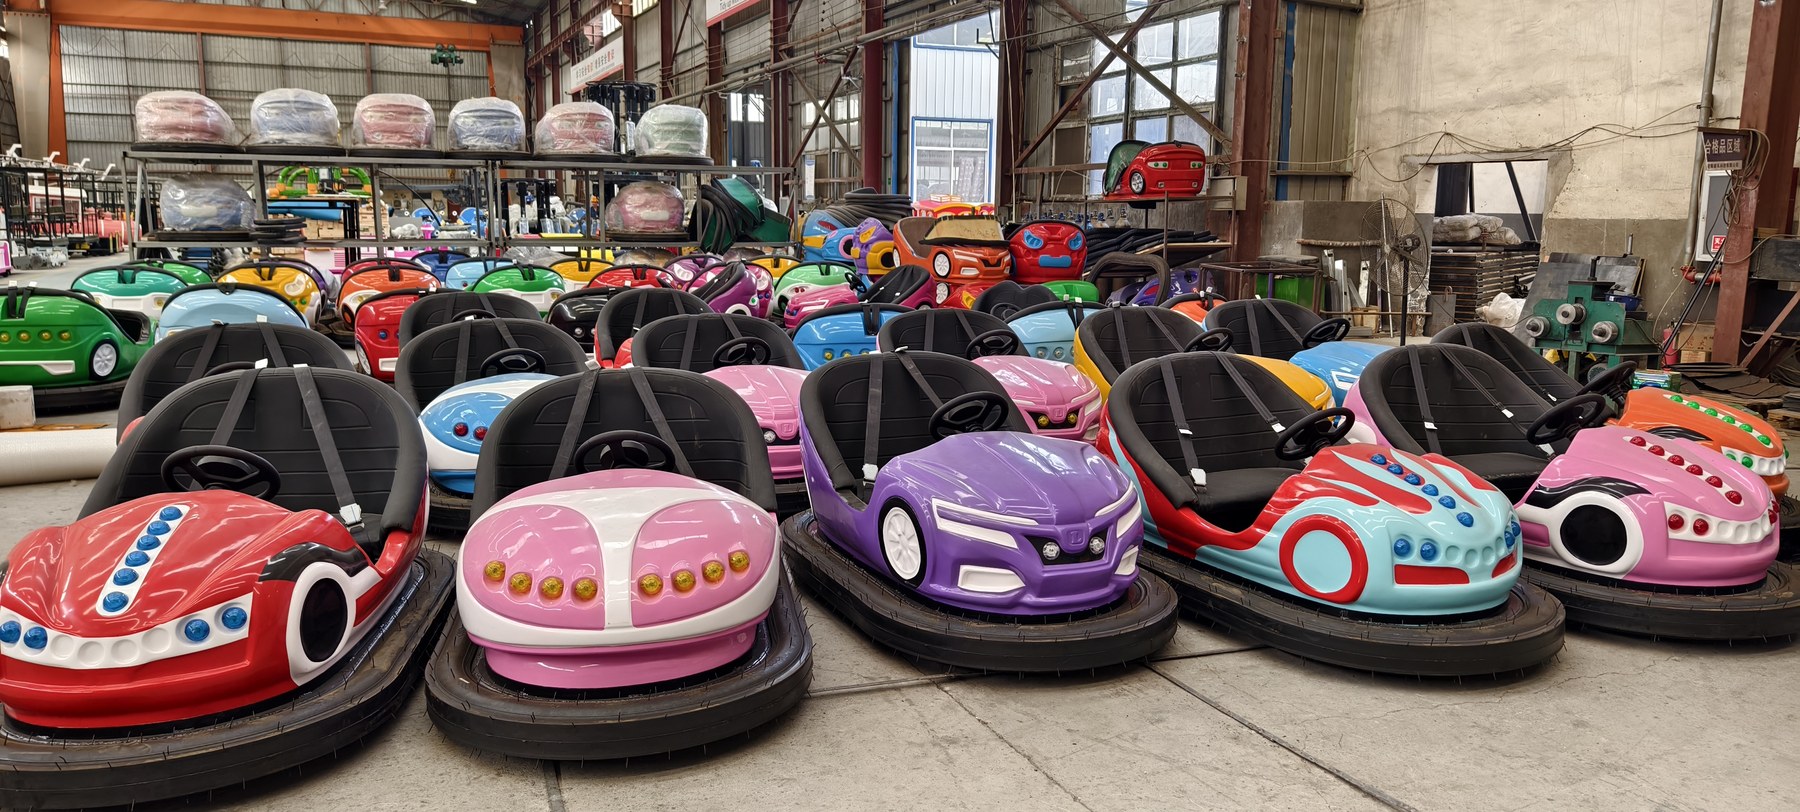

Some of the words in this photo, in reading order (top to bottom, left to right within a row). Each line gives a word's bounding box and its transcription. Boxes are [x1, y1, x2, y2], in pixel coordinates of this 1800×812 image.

[1705, 138, 1740, 154] 合格品区域
